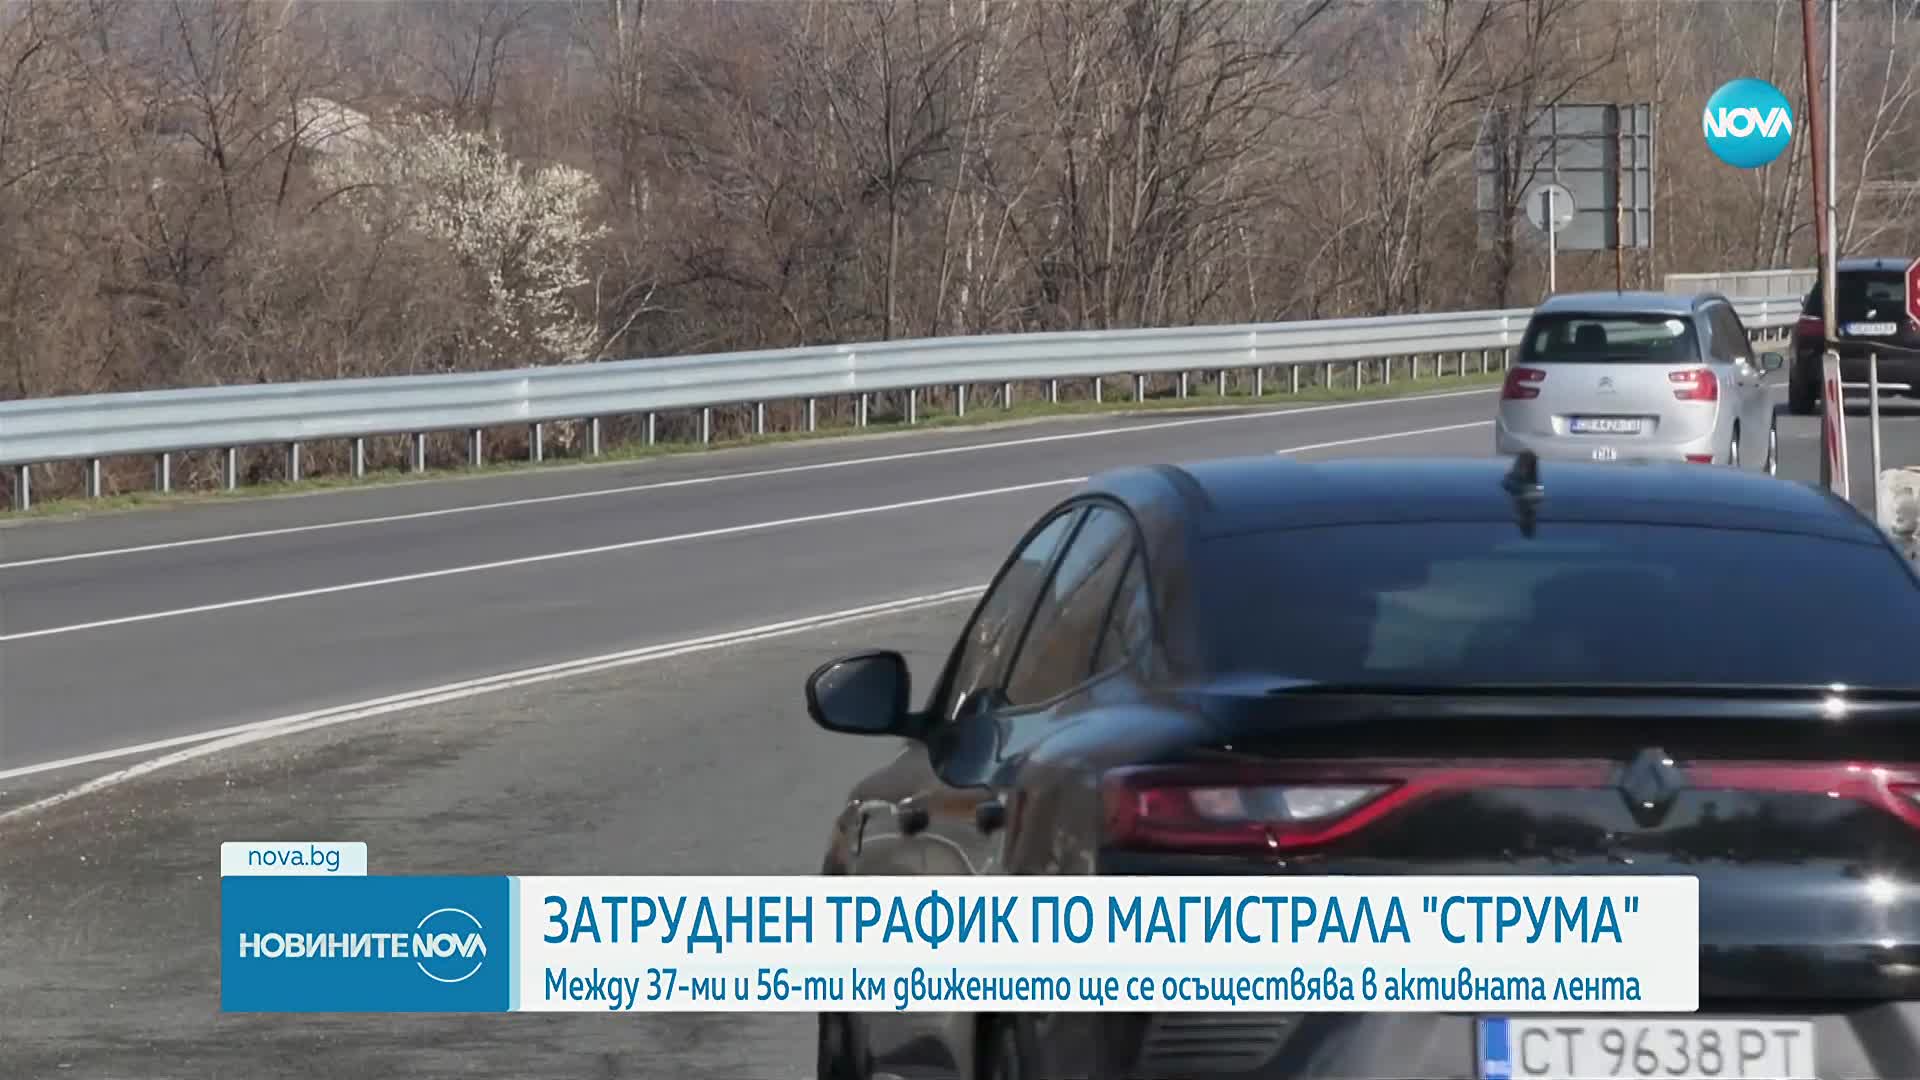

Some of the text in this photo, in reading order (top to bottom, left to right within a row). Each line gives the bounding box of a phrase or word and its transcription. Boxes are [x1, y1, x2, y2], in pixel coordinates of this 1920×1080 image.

[1520, 1027, 1800, 1076] CT 9638 PT
